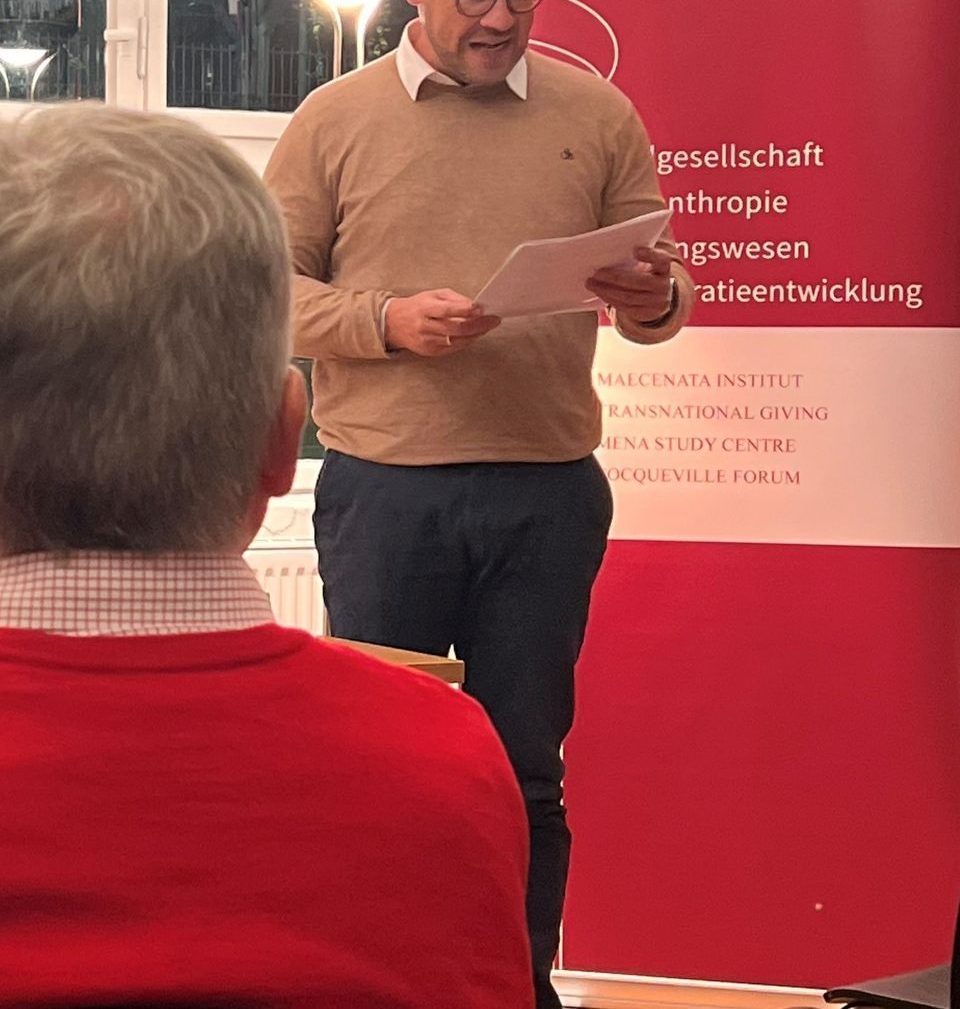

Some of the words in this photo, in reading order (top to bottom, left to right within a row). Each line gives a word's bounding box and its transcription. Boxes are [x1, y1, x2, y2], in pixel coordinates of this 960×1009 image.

[597, 373, 710, 388] MAECENATA
[717, 373, 804, 389] INSTITUT
[604, 404, 755, 420] RANSNATIONAL
[759, 406, 829, 421] GIVING
[655, 436, 718, 452] STUDY
[721, 438, 797, 453] CENTRE
[603, 467, 727, 486] OCQUEVILLE
[733, 469, 801, 485] FORUM
